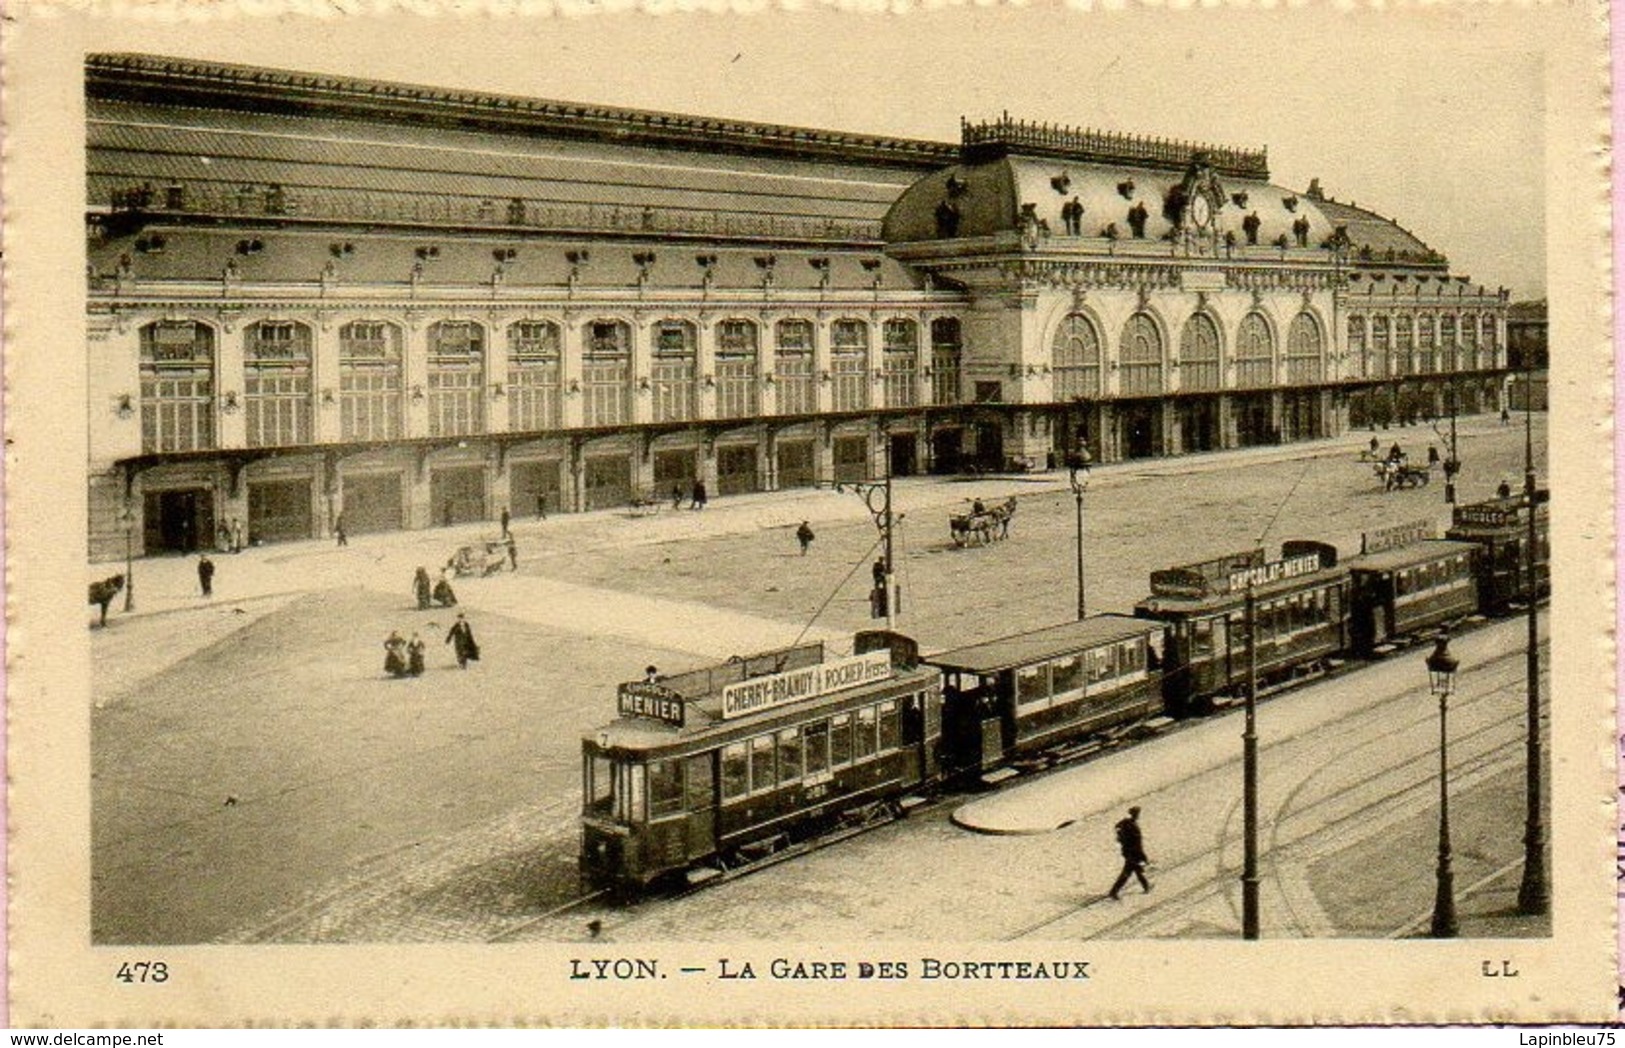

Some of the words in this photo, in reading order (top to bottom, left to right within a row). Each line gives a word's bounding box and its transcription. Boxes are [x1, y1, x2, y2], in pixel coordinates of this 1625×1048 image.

[725, 670, 814, 713] CHERRY-BRANDY
[825, 661, 864, 689] ROCHER
[621, 694, 681, 719] MENIER
[116, 961, 169, 983] 473
[570, 958, 667, 980] LYON.
[858, 962, 908, 979] DES
[921, 958, 1090, 979] BORTTEAUX
[1482, 960, 1519, 977] LL
